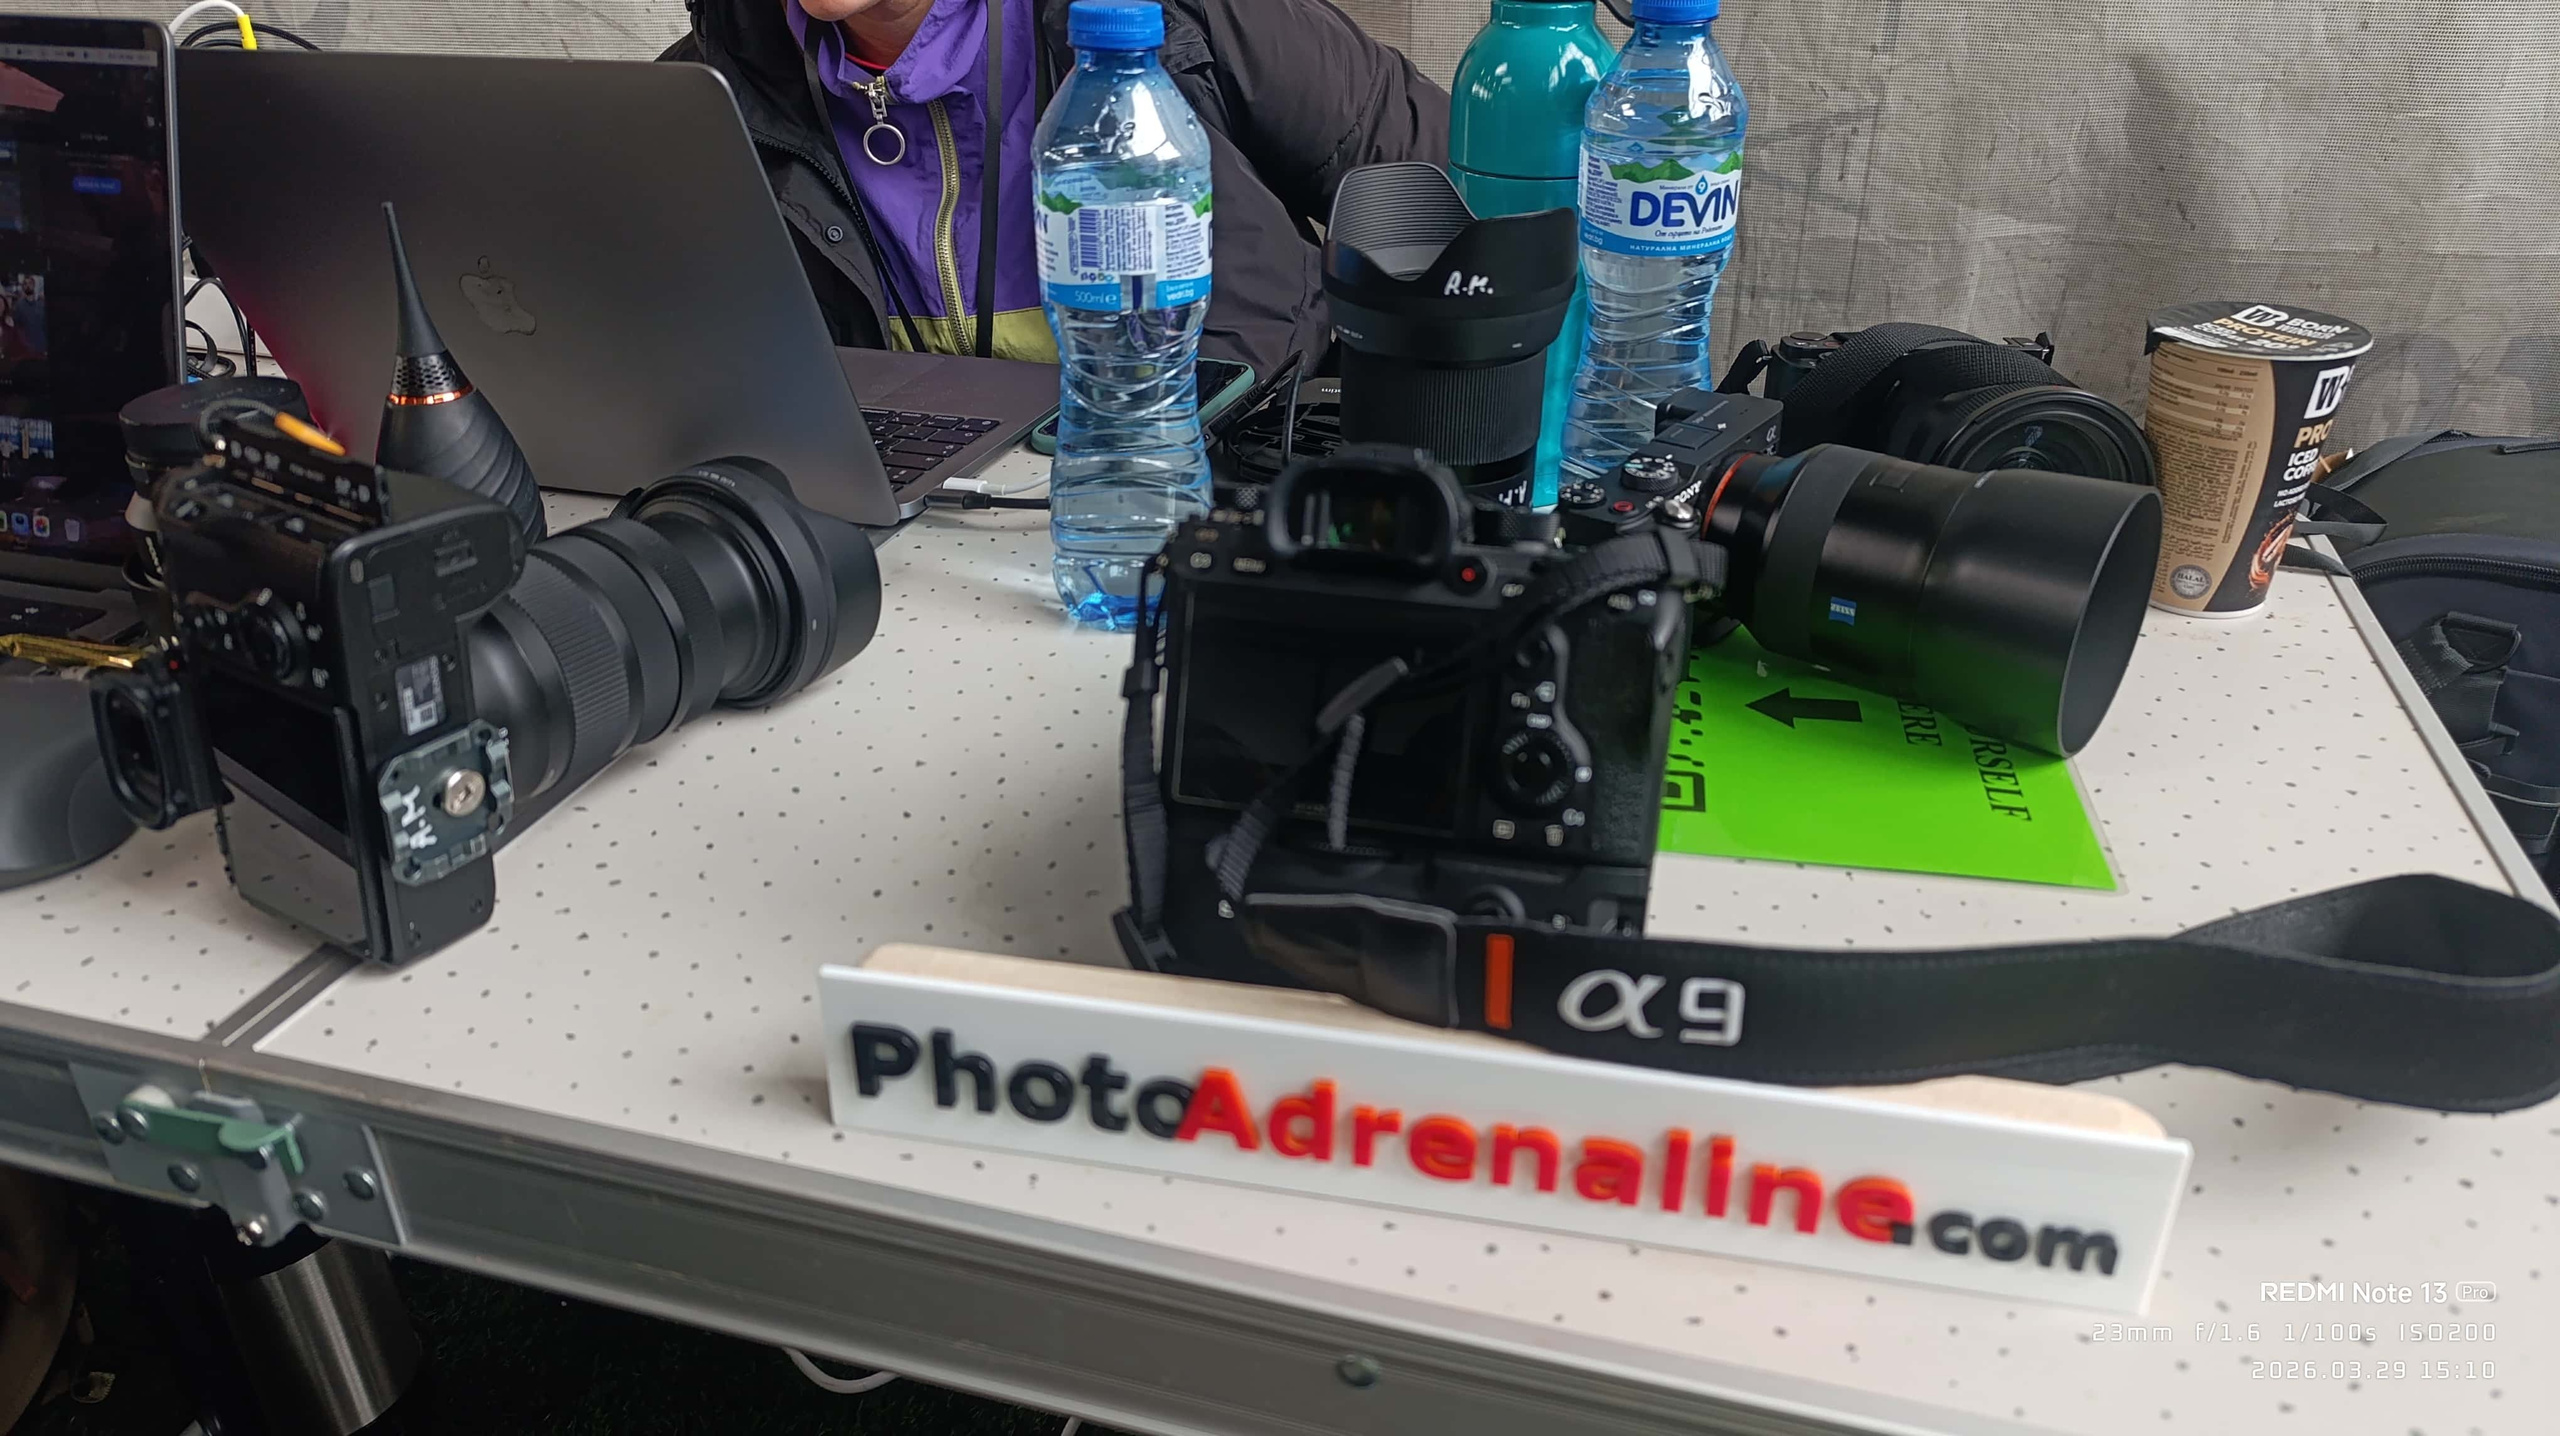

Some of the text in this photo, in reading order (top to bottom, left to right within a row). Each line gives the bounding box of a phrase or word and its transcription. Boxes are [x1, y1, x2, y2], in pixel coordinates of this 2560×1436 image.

[1697, 181, 1706, 193] 9
[1630, 180, 1739, 228] DEVIN
[2212, 317, 2318, 347] PROTEIN
[2284, 318, 2350, 333] BORN
[2287, 447, 2319, 467] ICED
